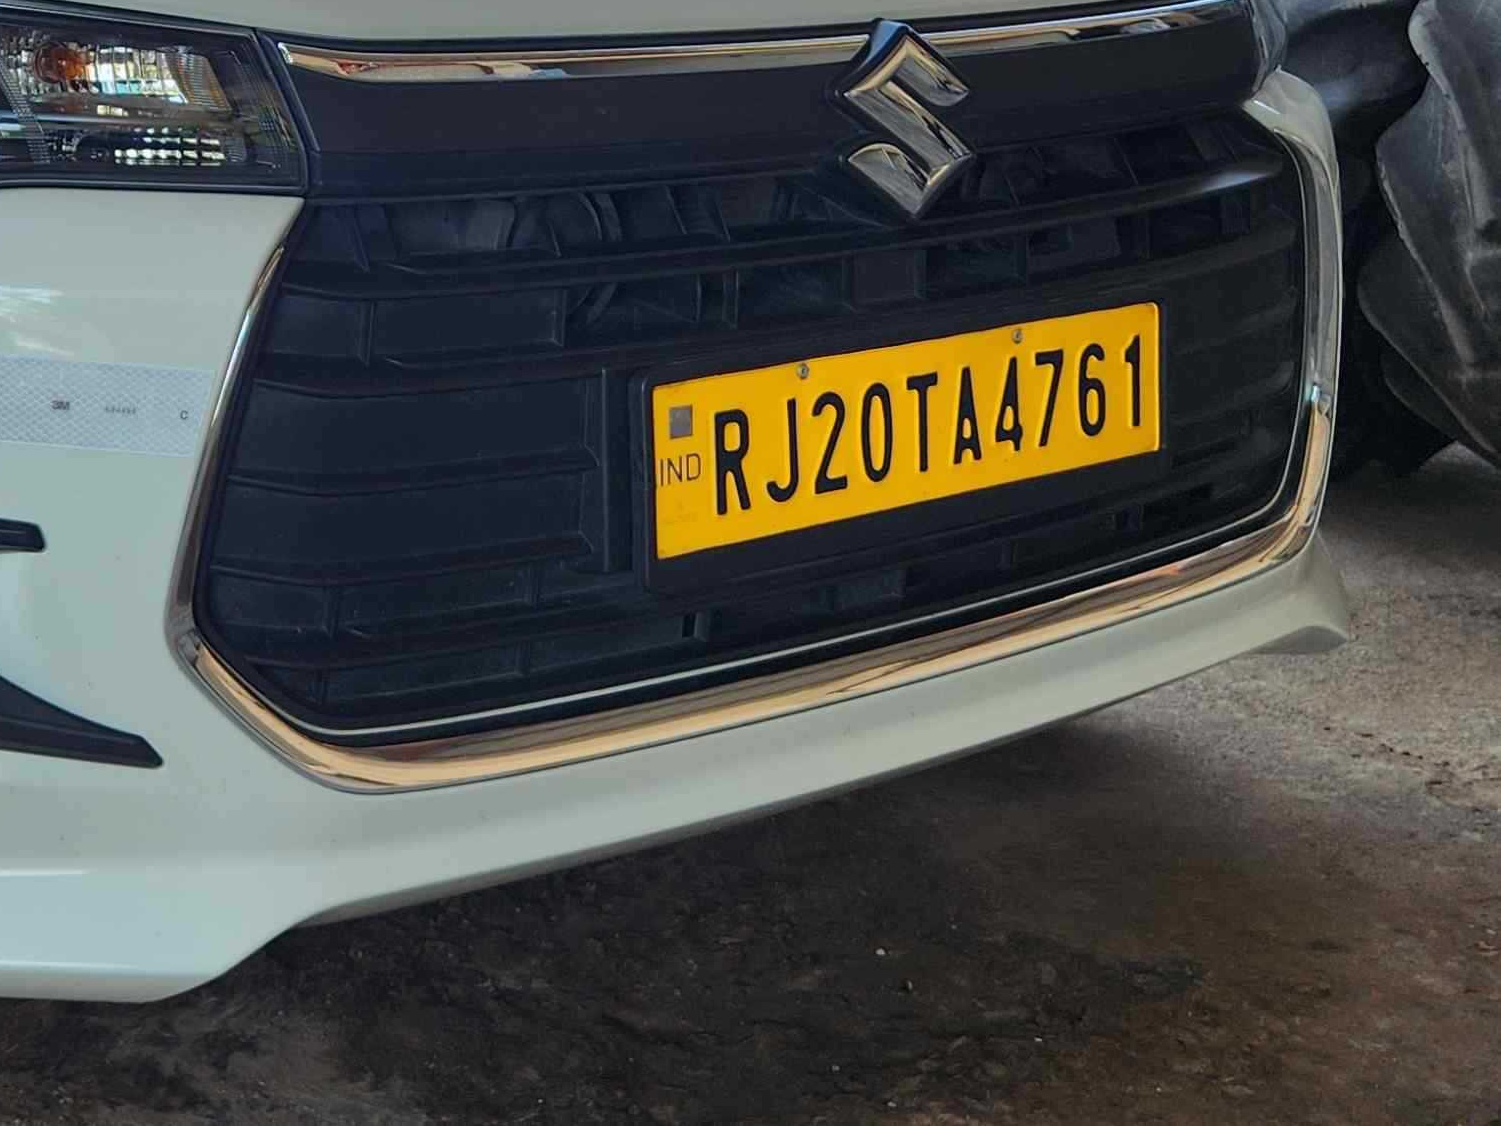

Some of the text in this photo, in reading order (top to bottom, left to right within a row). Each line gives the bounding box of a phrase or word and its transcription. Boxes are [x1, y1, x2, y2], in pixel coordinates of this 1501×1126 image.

[51, 399, 189, 421] 3M C
[713, 334, 1142, 516] RJ20TA4761
[659, 452, 702, 487] IND
